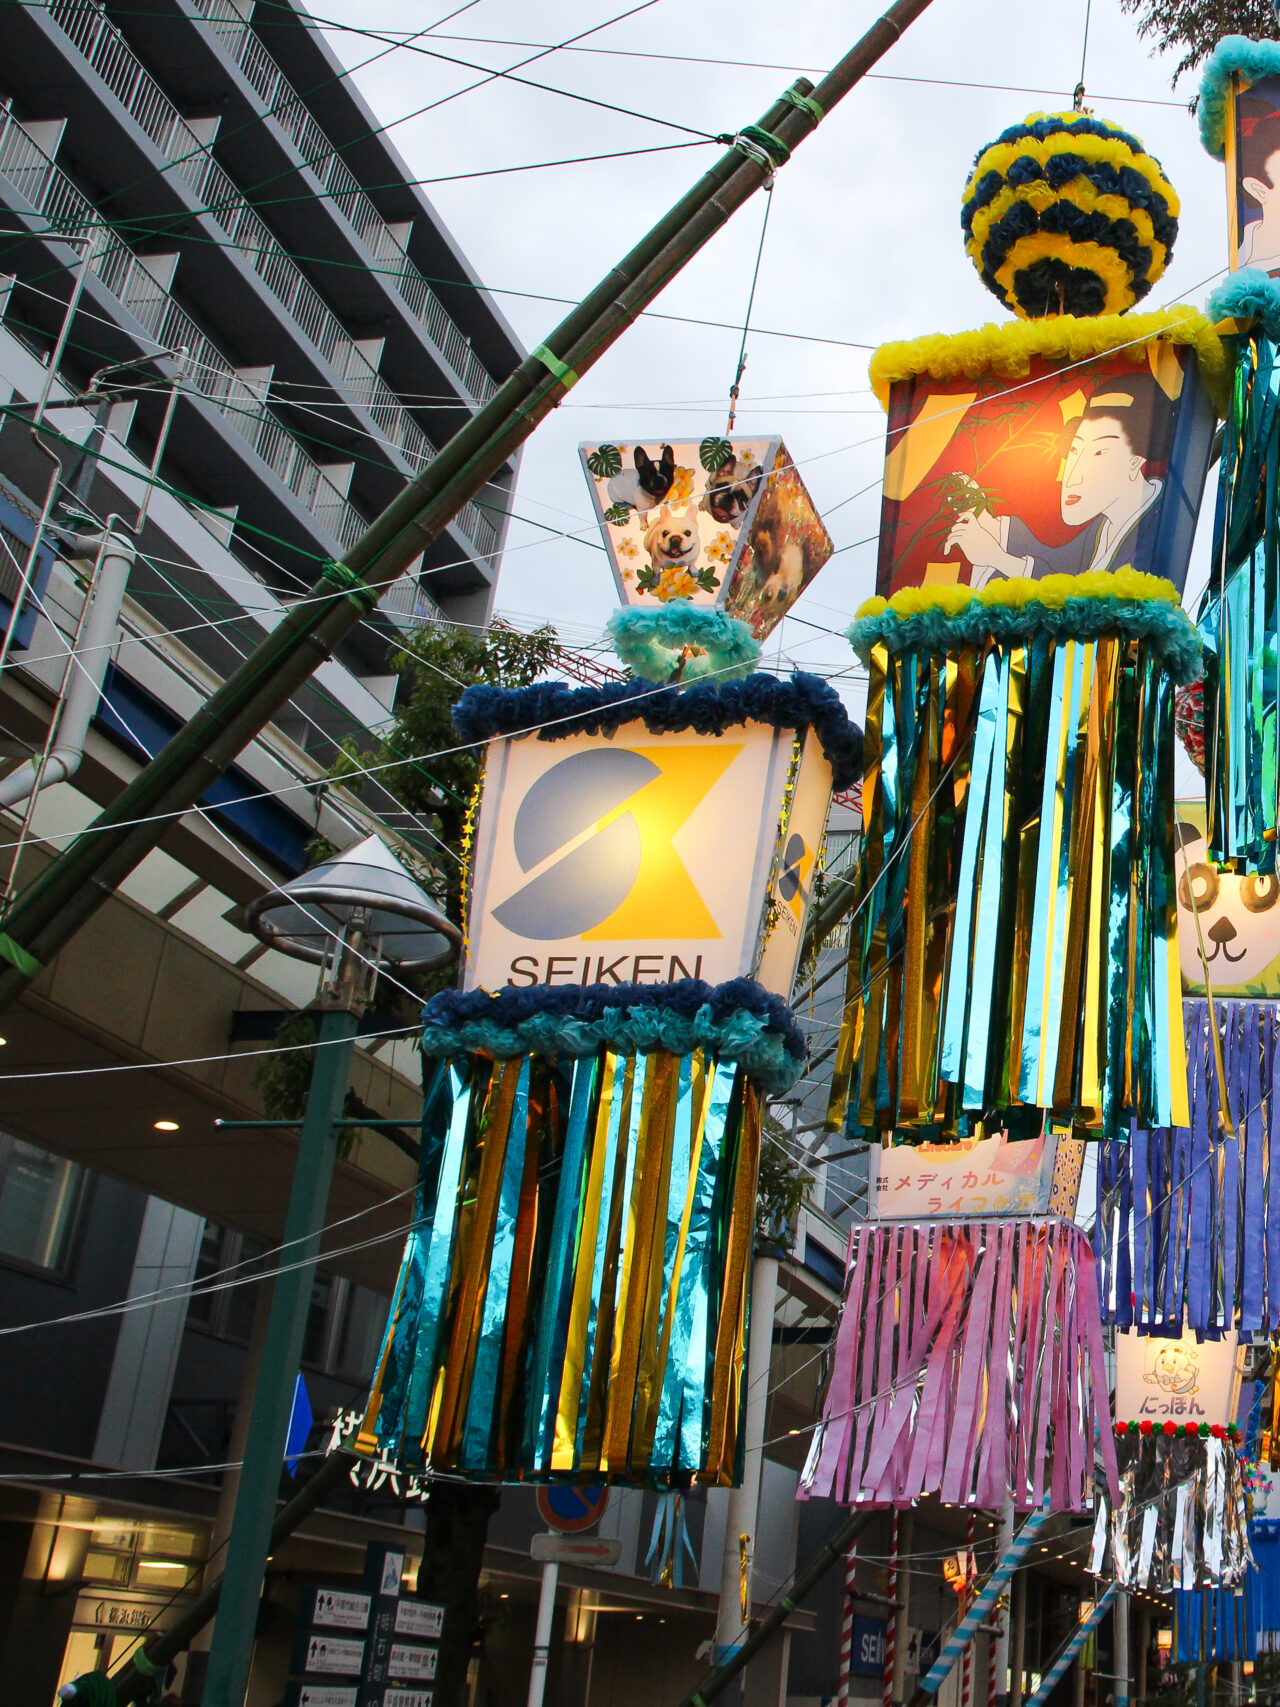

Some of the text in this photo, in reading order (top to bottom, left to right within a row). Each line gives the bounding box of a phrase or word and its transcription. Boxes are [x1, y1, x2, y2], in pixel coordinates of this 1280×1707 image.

[507, 955, 703, 989] SEIKEN
[894, 1171, 1005, 1192] メディカル
[928, 1195, 1035, 1215] ライフケア
[1139, 1396, 1206, 1416] にっぽん
